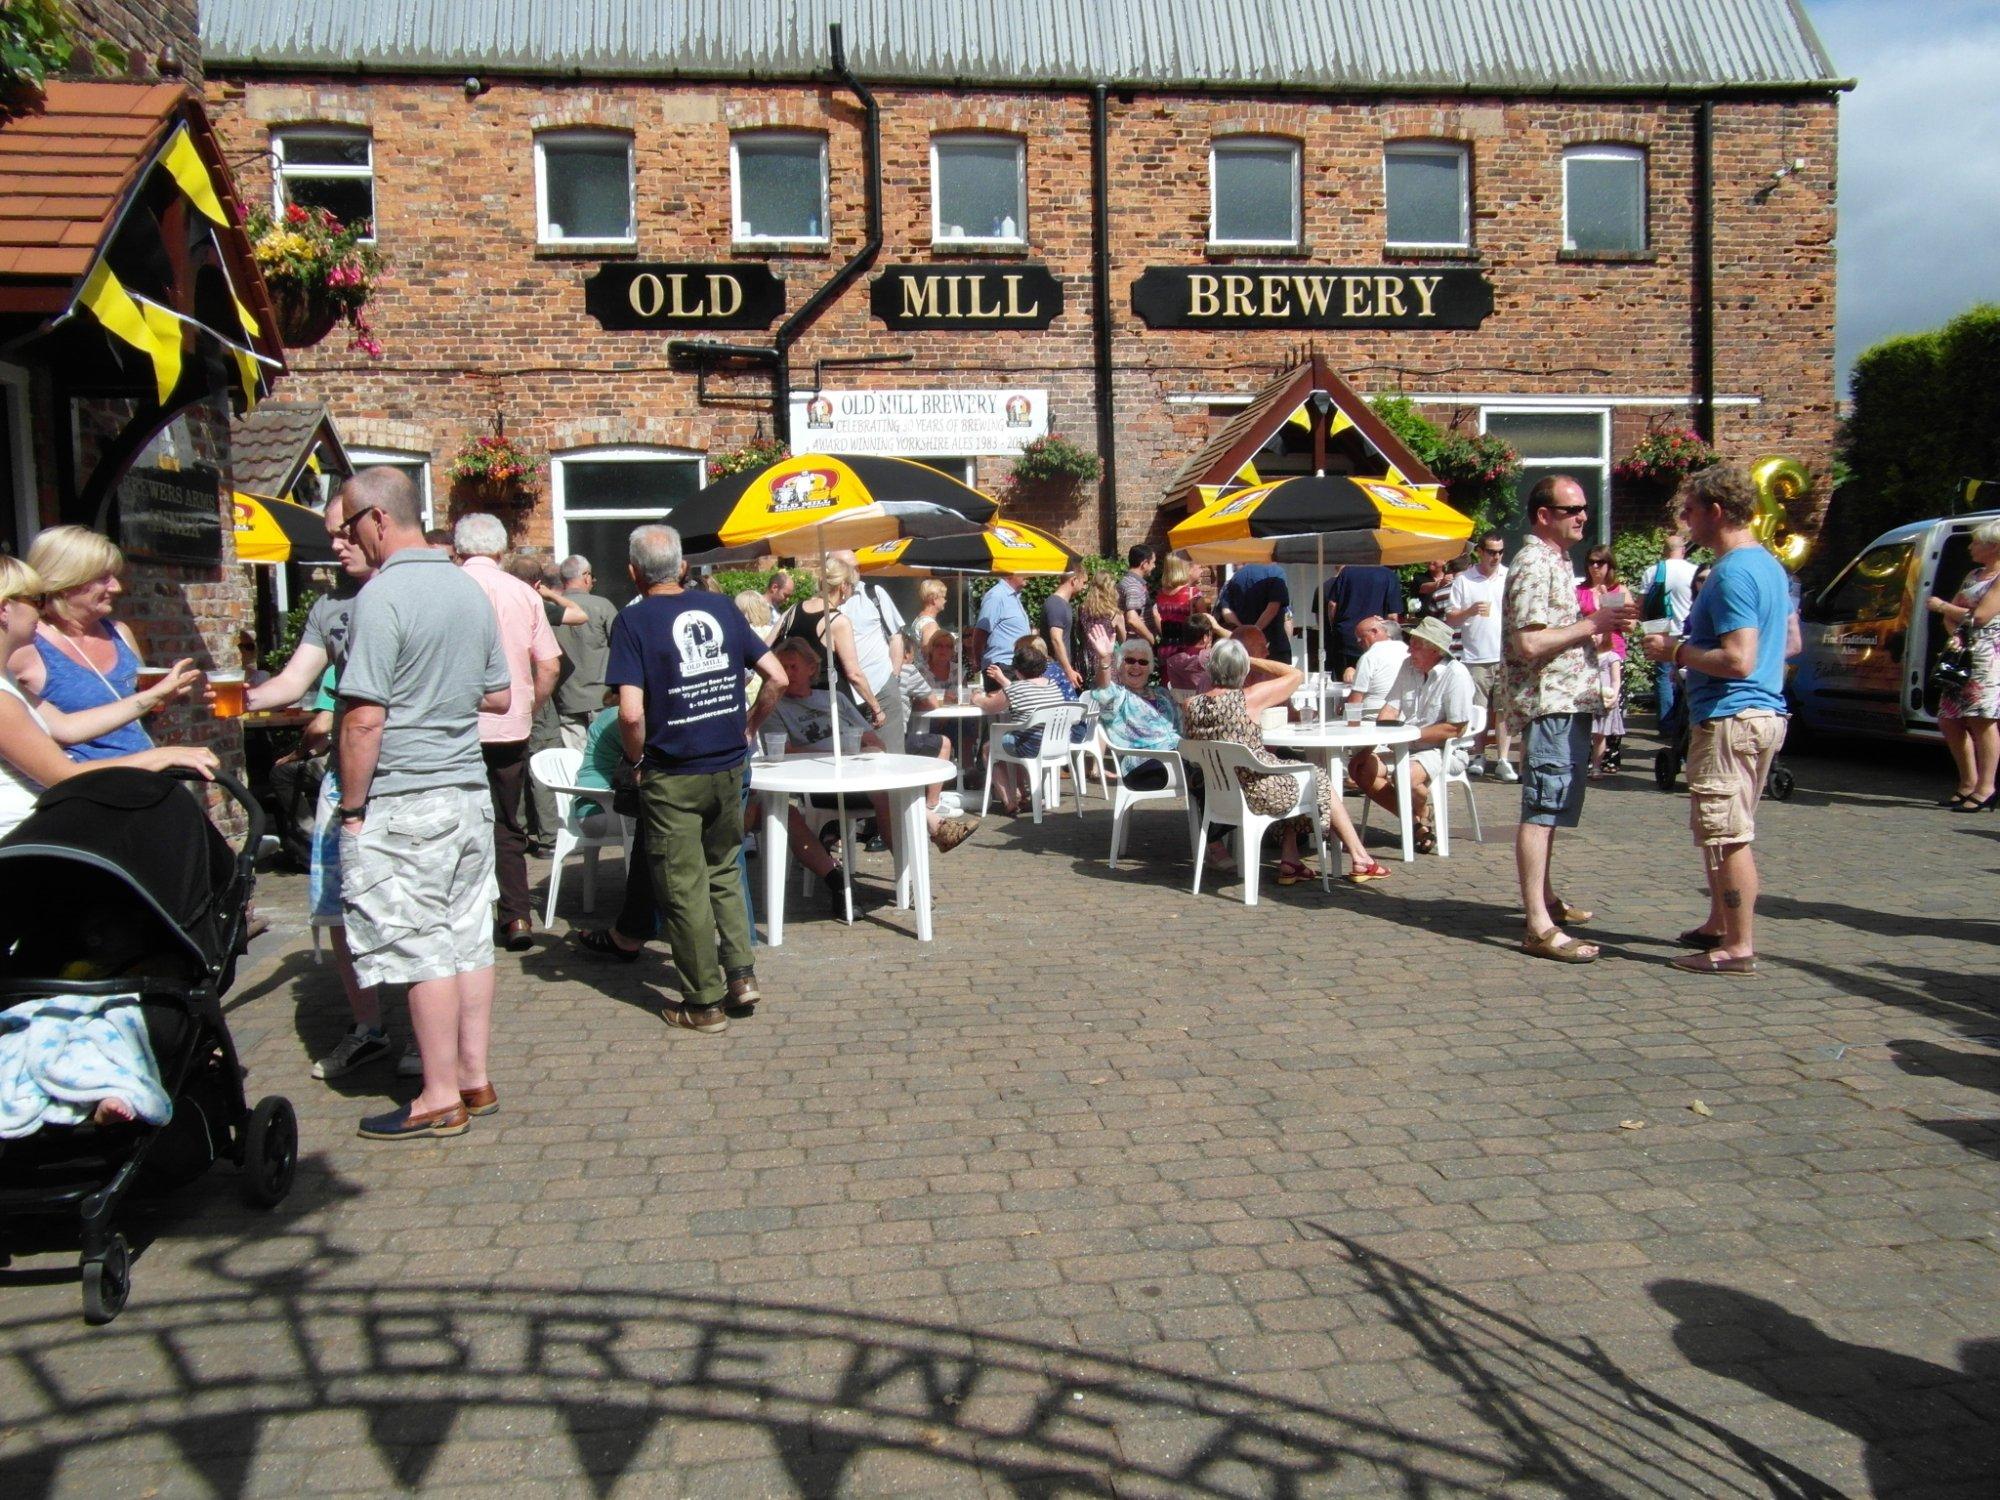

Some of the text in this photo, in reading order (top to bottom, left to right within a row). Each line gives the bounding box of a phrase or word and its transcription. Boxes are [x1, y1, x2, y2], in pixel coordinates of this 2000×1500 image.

[629, 273, 743, 318] OLD
[900, 275, 1038, 318] MILL
[1187, 274, 1443, 317] BREWERY
[842, 393, 997, 415] OLD MILL BREWERY
[836, 419, 901, 434] CELEBRATING
[916, 418, 944, 432] YEARS
[947, 418, 958, 433] OF
[961, 417, 1004, 433] BREWING
[812, 438, 848, 452] AWARD
[850, 437, 894, 451] WINNING
[896, 436, 950, 451] YORKSHIRE
[952, 436, 973, 450] ALES
[976, 436, 998, 450] 1983
[1839, 634, 1878, 645] Traditional
[686, 662, 701, 671] OLD
[702, 658, 723, 667] MILL
[704, 697, 718, 705] April
